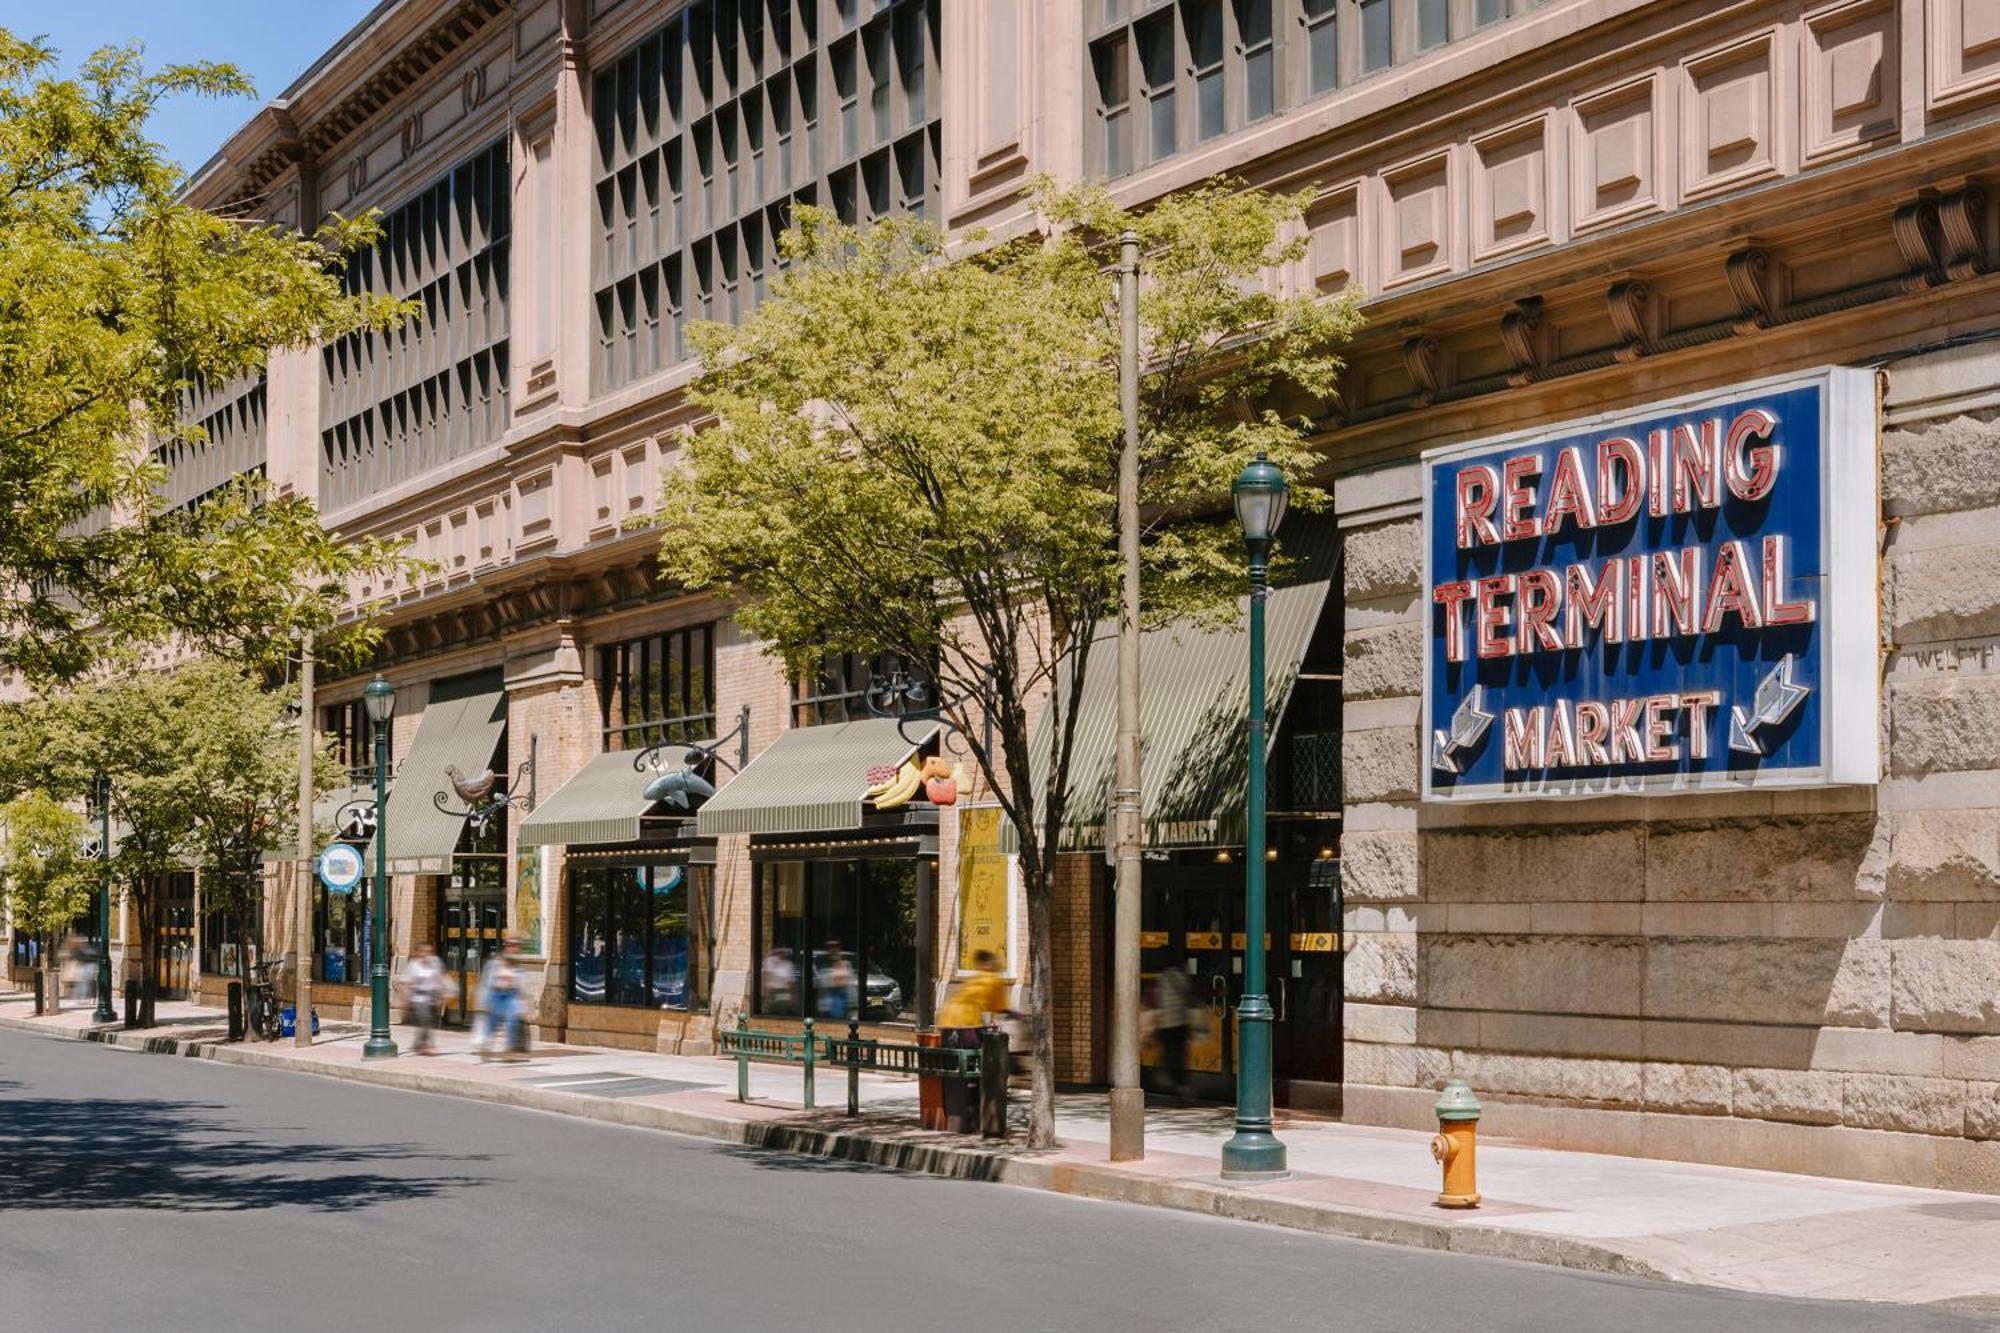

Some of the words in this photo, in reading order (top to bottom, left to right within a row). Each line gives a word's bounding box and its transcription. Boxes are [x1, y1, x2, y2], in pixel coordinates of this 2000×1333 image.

[1456, 409, 1780, 549] READING
[1433, 535, 1815, 662] TERMINAL
[1504, 690, 1720, 770] MARKET
[1158, 819, 1217, 844] MARKET
